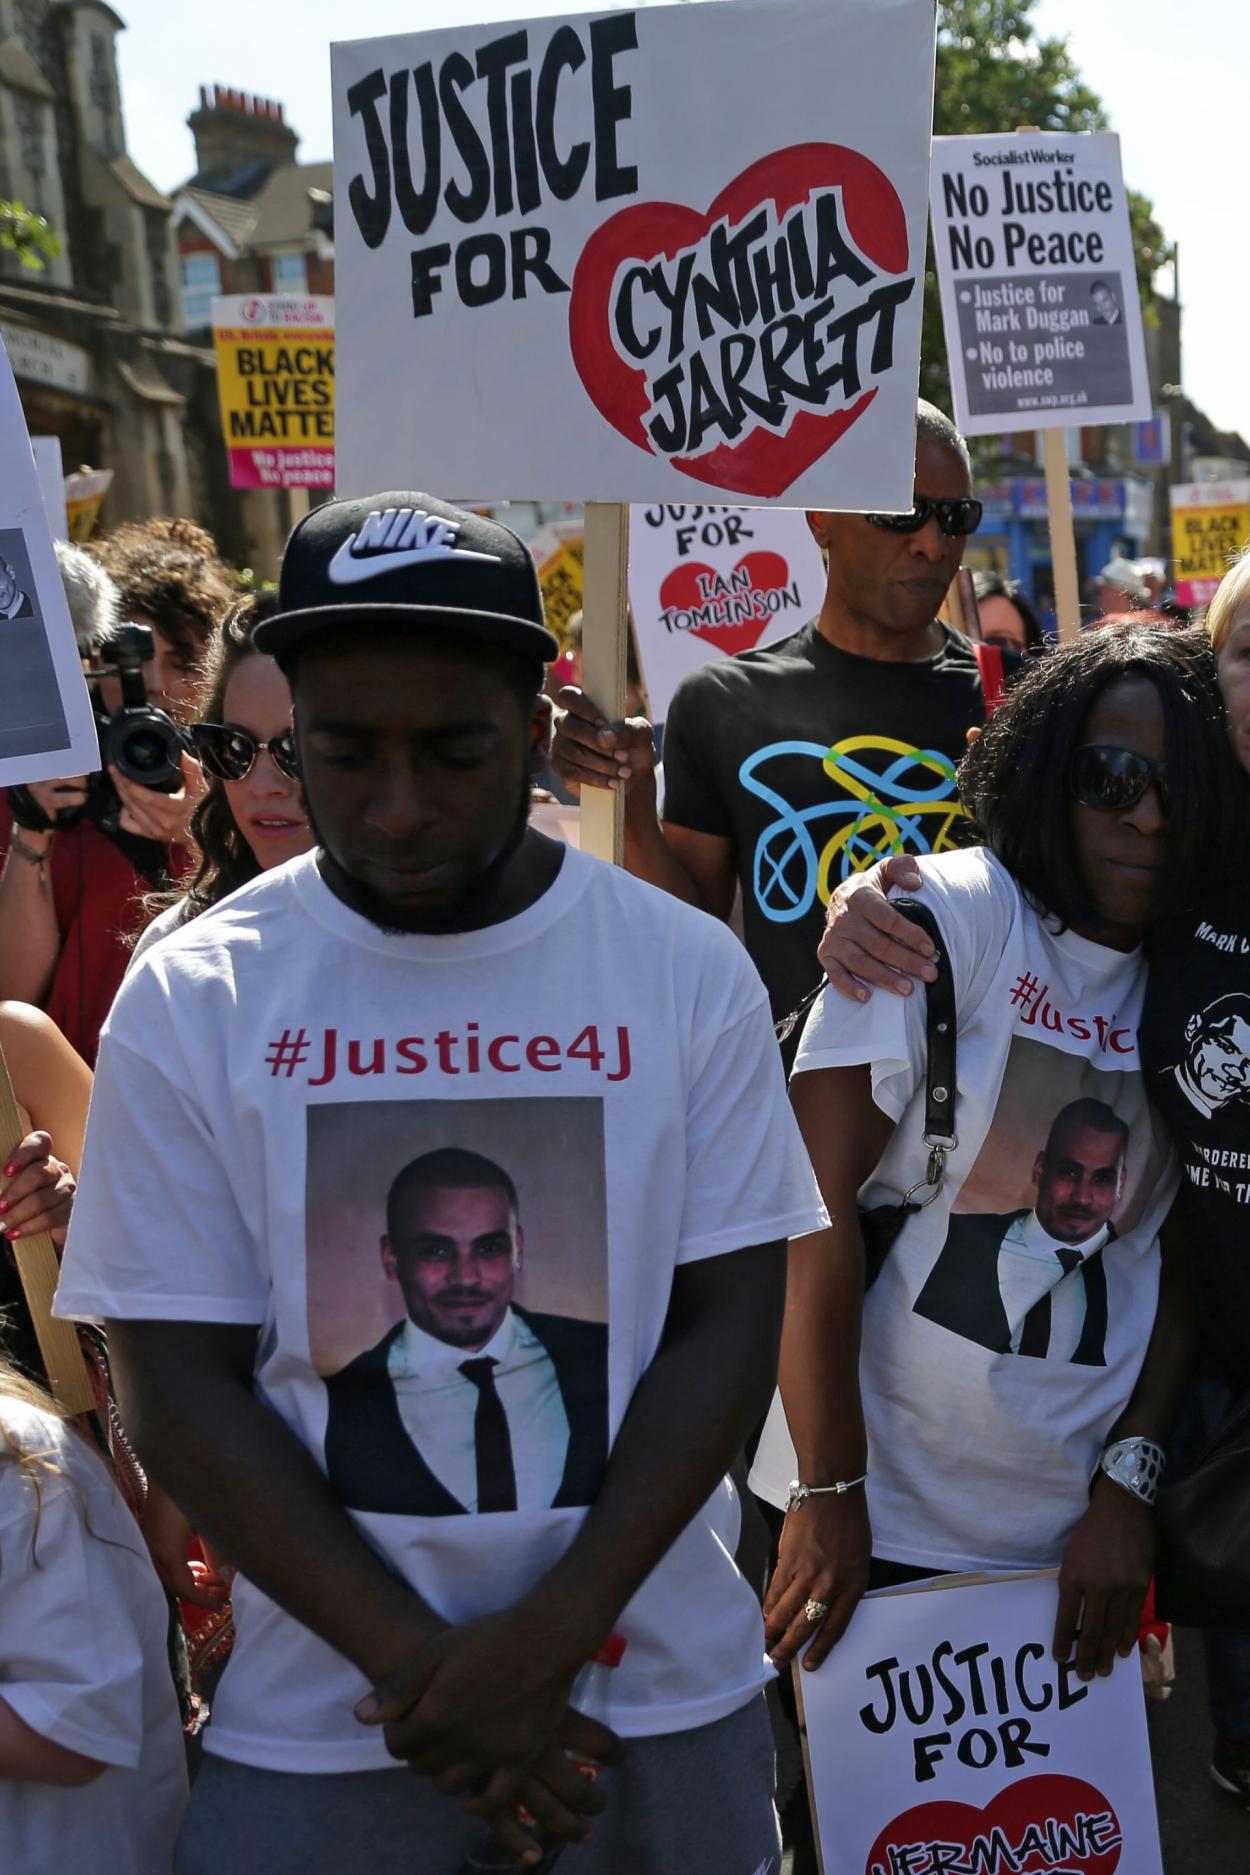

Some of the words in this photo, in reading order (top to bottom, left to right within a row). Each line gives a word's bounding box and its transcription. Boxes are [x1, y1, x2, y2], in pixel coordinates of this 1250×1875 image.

[347, 12, 638, 249] JUSTICE
[942, 172, 989, 218] No
[1002, 168, 1113, 216] Justice
[949, 224, 995, 270] No
[1003, 222, 1104, 267] Peace
[411, 226, 571, 318] FOR
[615, 192, 878, 360] CYNTHIA
[974, 282, 1035, 308] Justice
[1040, 280, 1065, 304] for
[976, 308, 1021, 333] Mark
[1026, 306, 1089, 333] Duggan
[237, 348, 335, 377] BLACK
[649, 277, 915, 454] JARRETT
[979, 340, 1003, 365] No
[1008, 339, 1028, 362] to
[1034, 336, 1085, 365] police
[247, 380, 331, 406] LIVES
[982, 366, 1054, 390] violence
[230, 410, 335, 437] MATTE
[352, 508, 461, 550] NIKE
[676, 515, 754, 556] FOR
[698, 567, 750, 599] IAN
[659, 581, 801, 633] TOMLINSON
[1195, 921, 1238, 953] MARK
[1010, 971, 1136, 1054] #Justic
[265, 1022, 633, 1086] #Justice4J
[913, 1717, 1051, 1783] FOR
